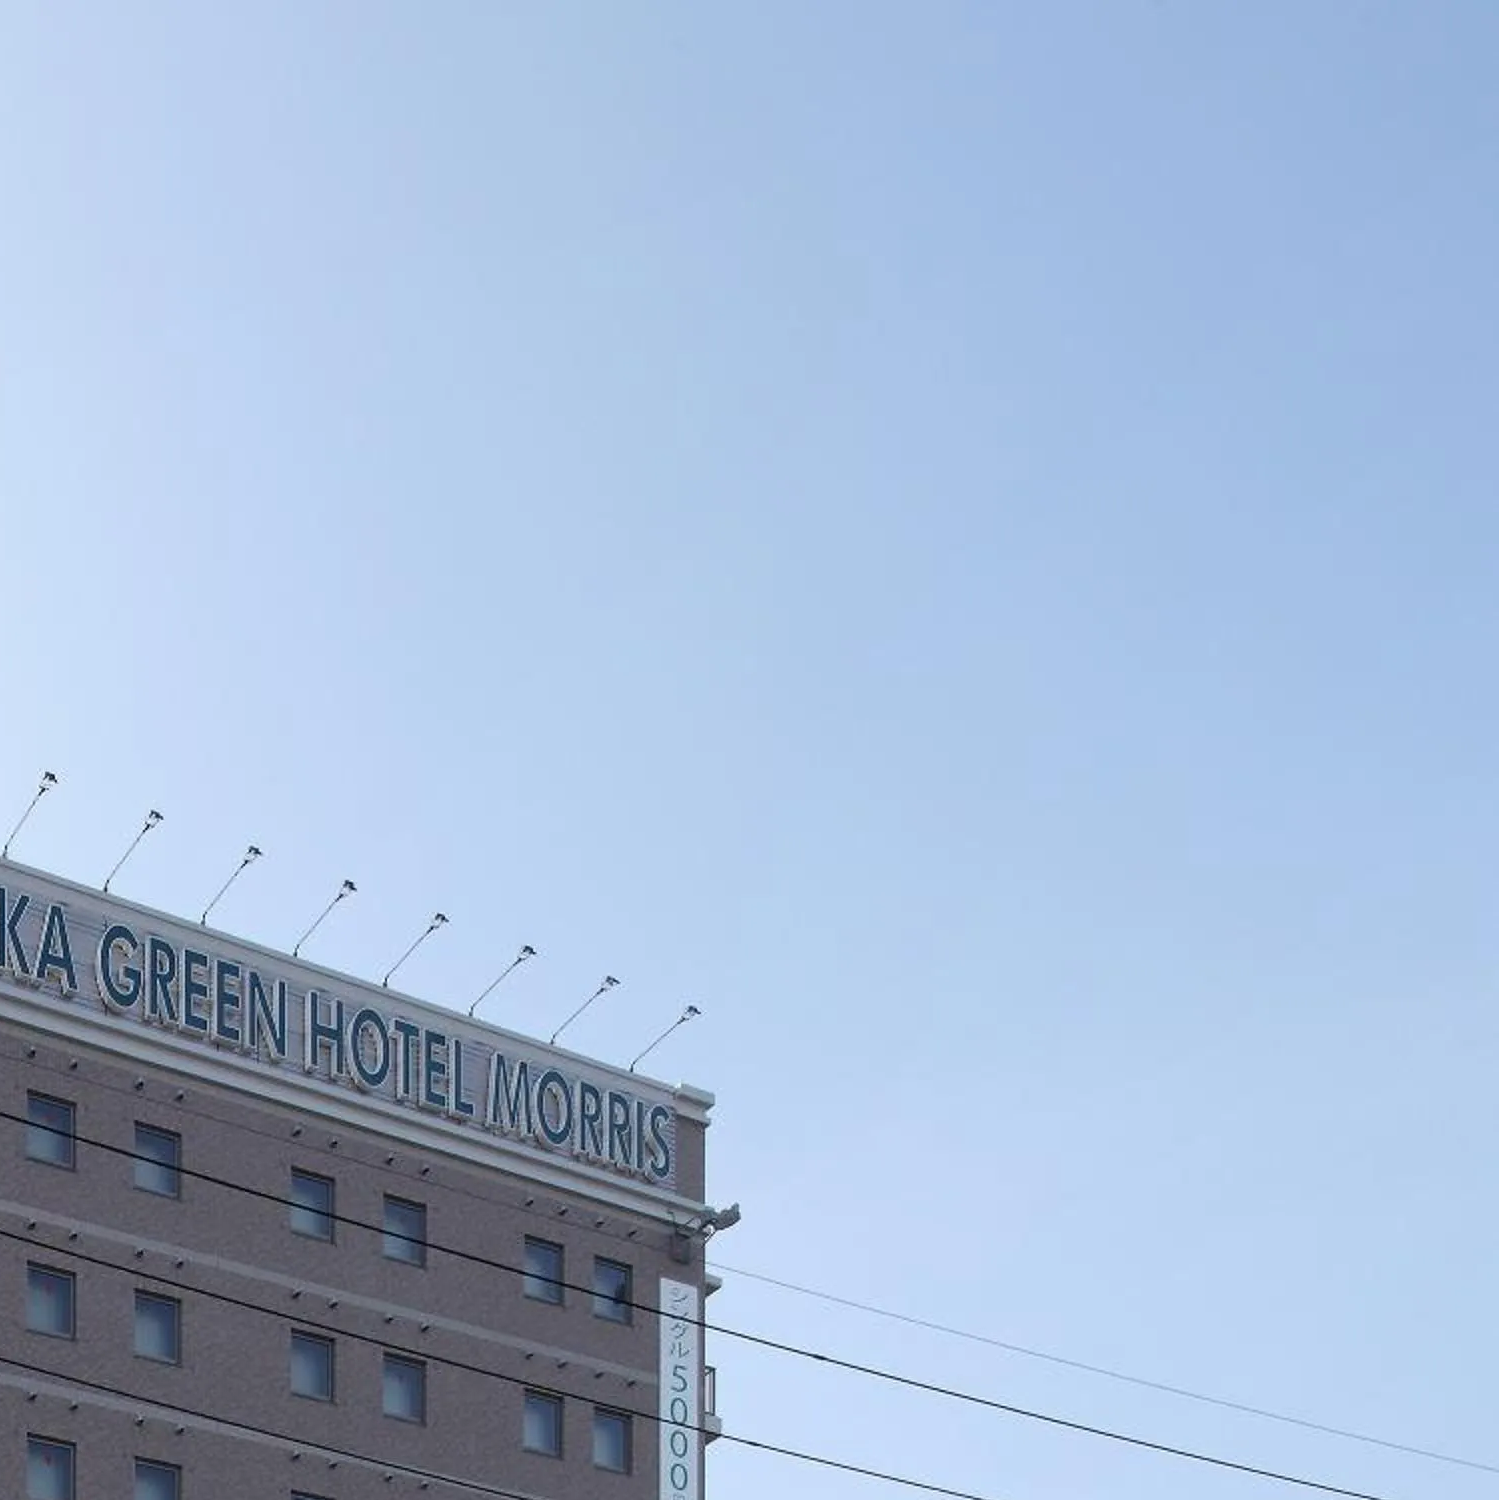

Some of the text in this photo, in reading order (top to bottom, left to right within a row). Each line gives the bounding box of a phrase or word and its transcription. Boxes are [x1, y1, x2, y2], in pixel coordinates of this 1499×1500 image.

[95, 921, 289, 1062] GREEN
[305, 989, 476, 1120] HOTEL
[486, 1050, 675, 1182] MORRIS
